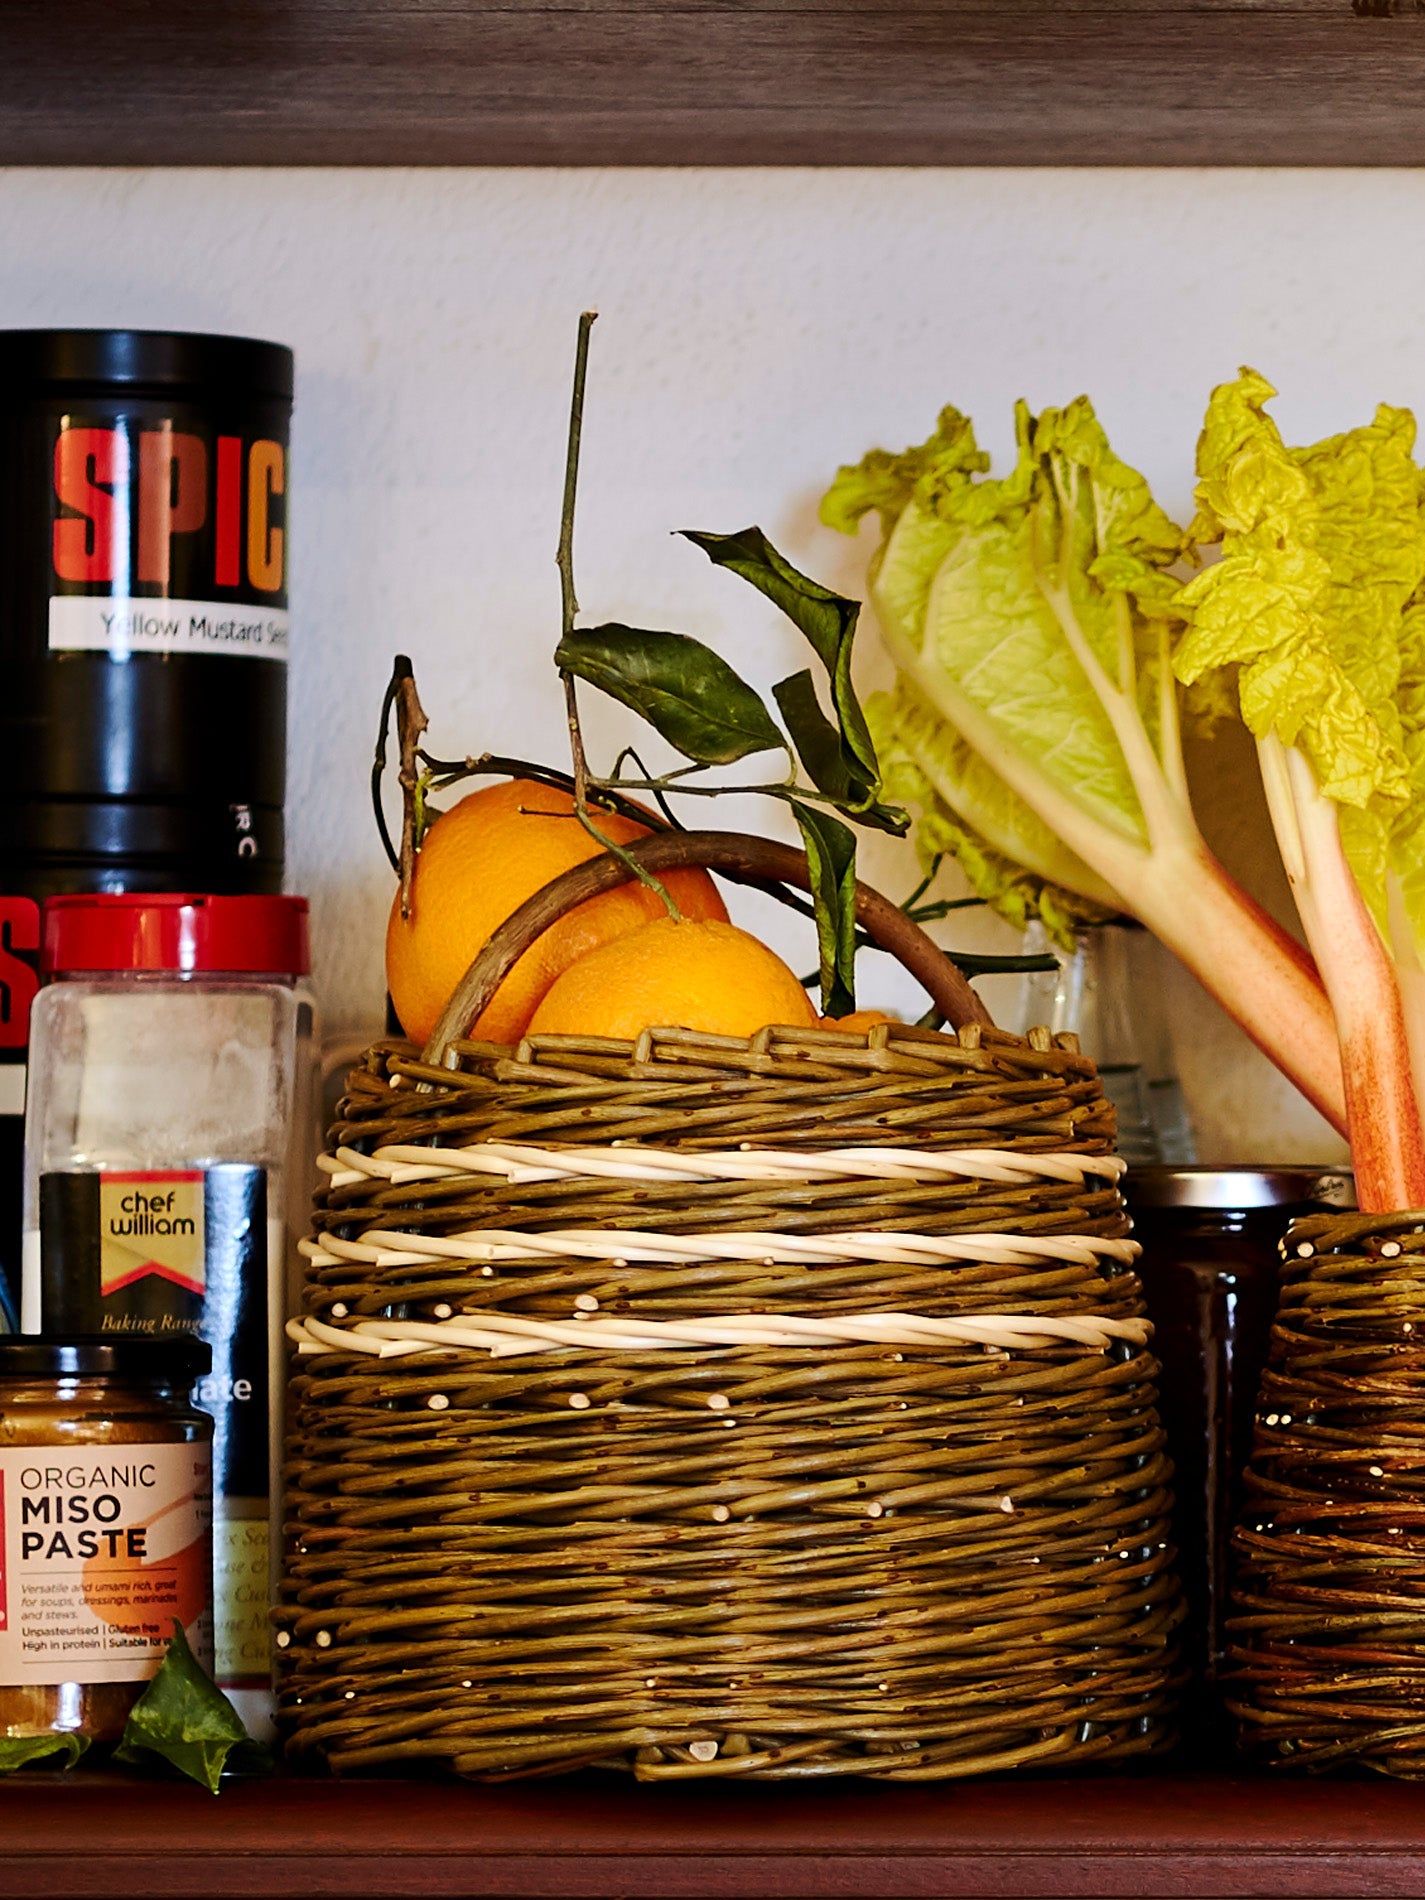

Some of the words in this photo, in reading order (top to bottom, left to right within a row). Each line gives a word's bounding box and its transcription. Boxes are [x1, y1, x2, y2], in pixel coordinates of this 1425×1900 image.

[53, 427, 288, 592] SPIC
[100, 611, 179, 638] Yellow
[189, 615, 262, 643] Mustard
[121, 1191, 175, 1214] chef
[111, 1213, 194, 1235] william
[101, 1314, 157, 1333] Baking
[20, 1464, 156, 1490] ORGANIC
[21, 1495, 121, 1525] MISO
[22, 1528, 147, 1560] PASTE
[22, 1626, 99, 1638] Unpasteurised
